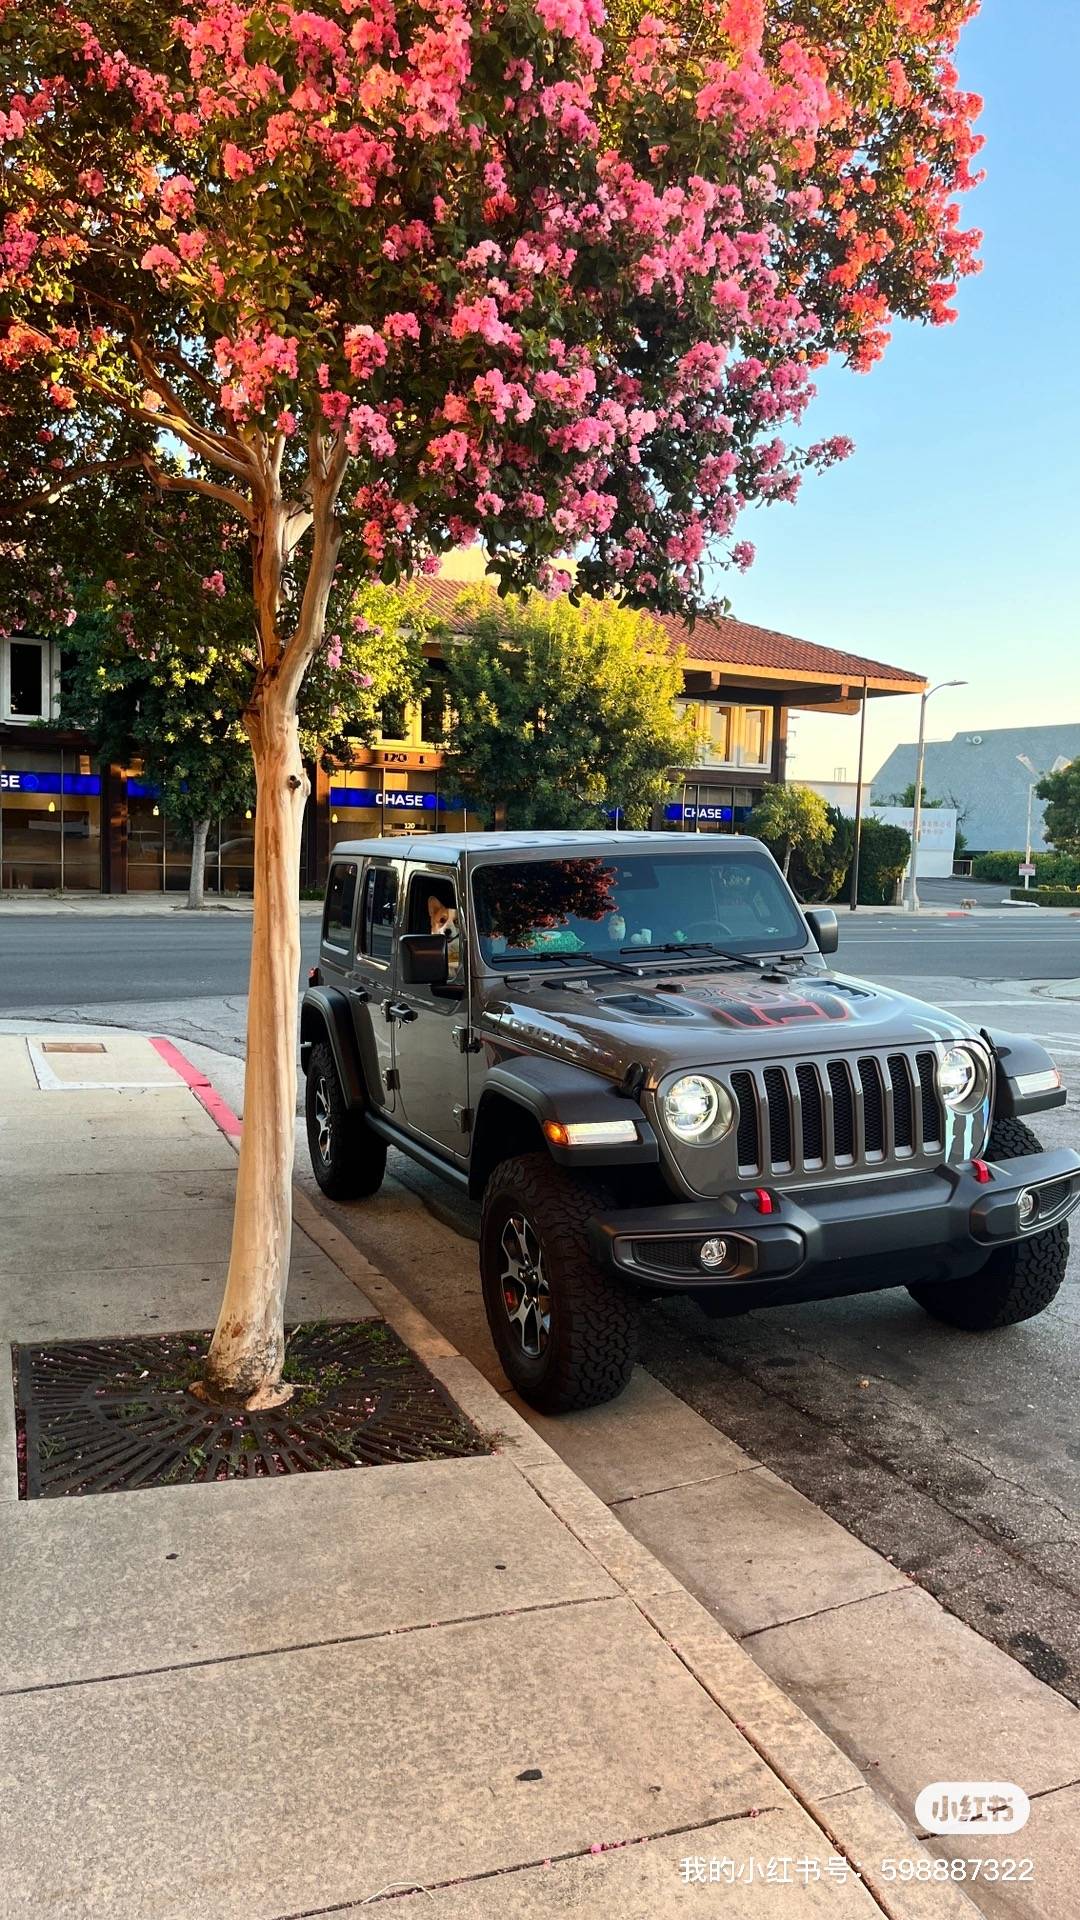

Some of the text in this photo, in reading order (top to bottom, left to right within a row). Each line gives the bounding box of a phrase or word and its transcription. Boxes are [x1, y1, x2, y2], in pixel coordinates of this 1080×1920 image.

[384, 753, 407, 762] 120
[375, 793, 423, 806] CHASE
[684, 807, 722, 818] CHASE
